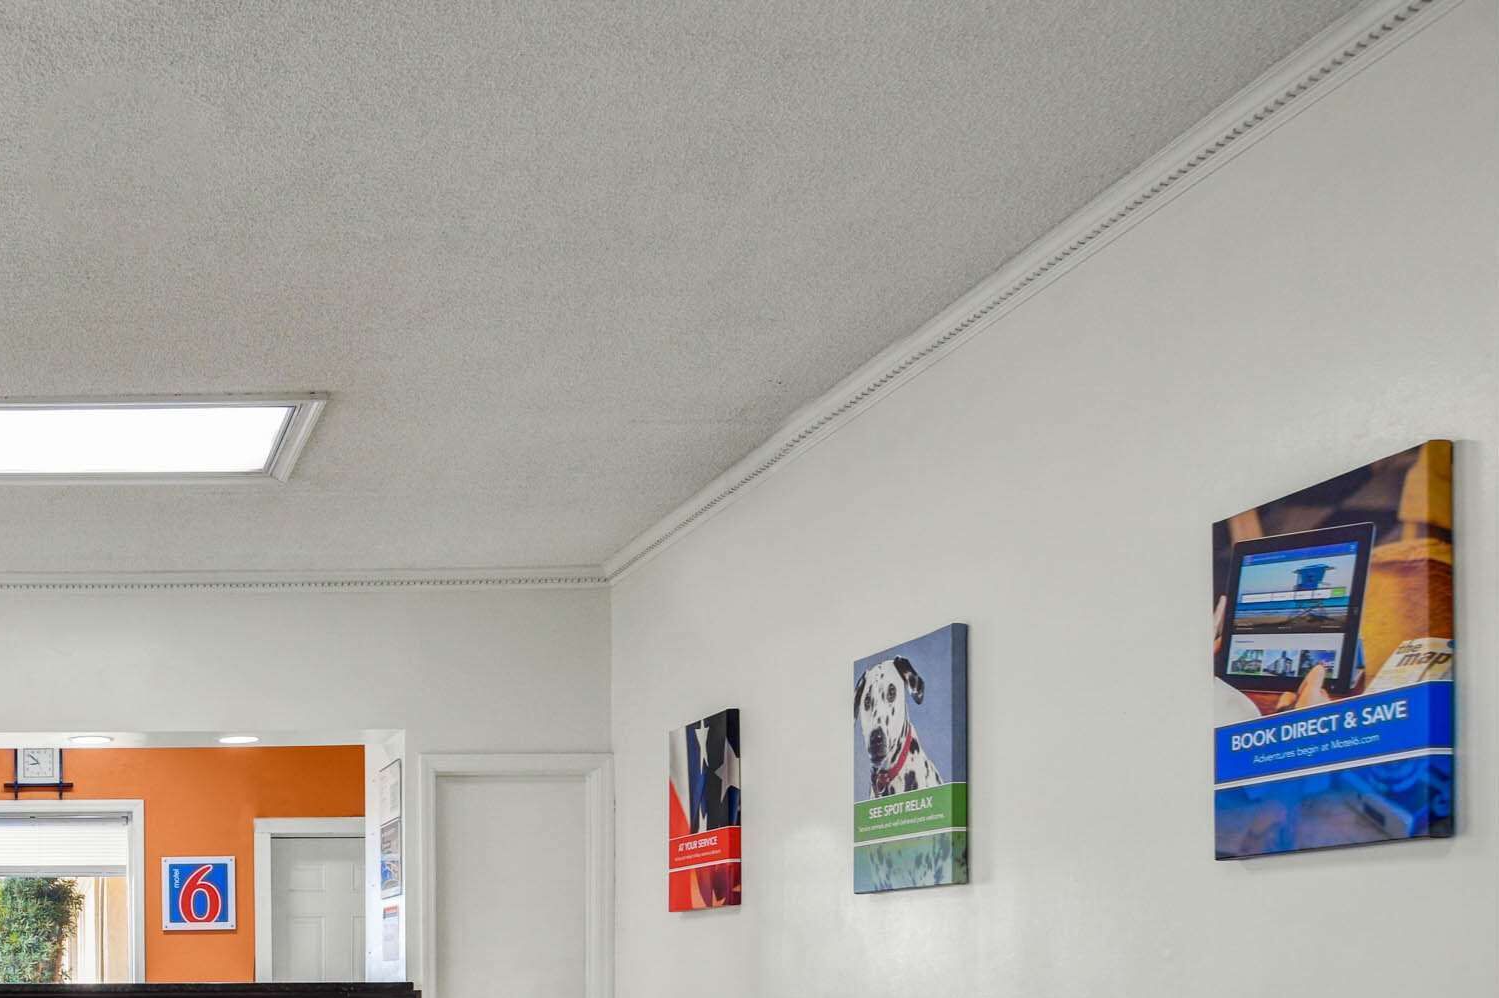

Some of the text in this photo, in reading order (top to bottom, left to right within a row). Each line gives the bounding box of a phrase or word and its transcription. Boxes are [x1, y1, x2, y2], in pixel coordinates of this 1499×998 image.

[1396, 650, 1453, 668] map
[1231, 700, 1407, 752] BOOK DIRECT & SAVE
[1253, 748, 1296, 765] Adventures
[1297, 743, 1320, 758] begin
[869, 796, 933, 819] SEE SPOT RELAX
[179, 864, 222, 923] 6
